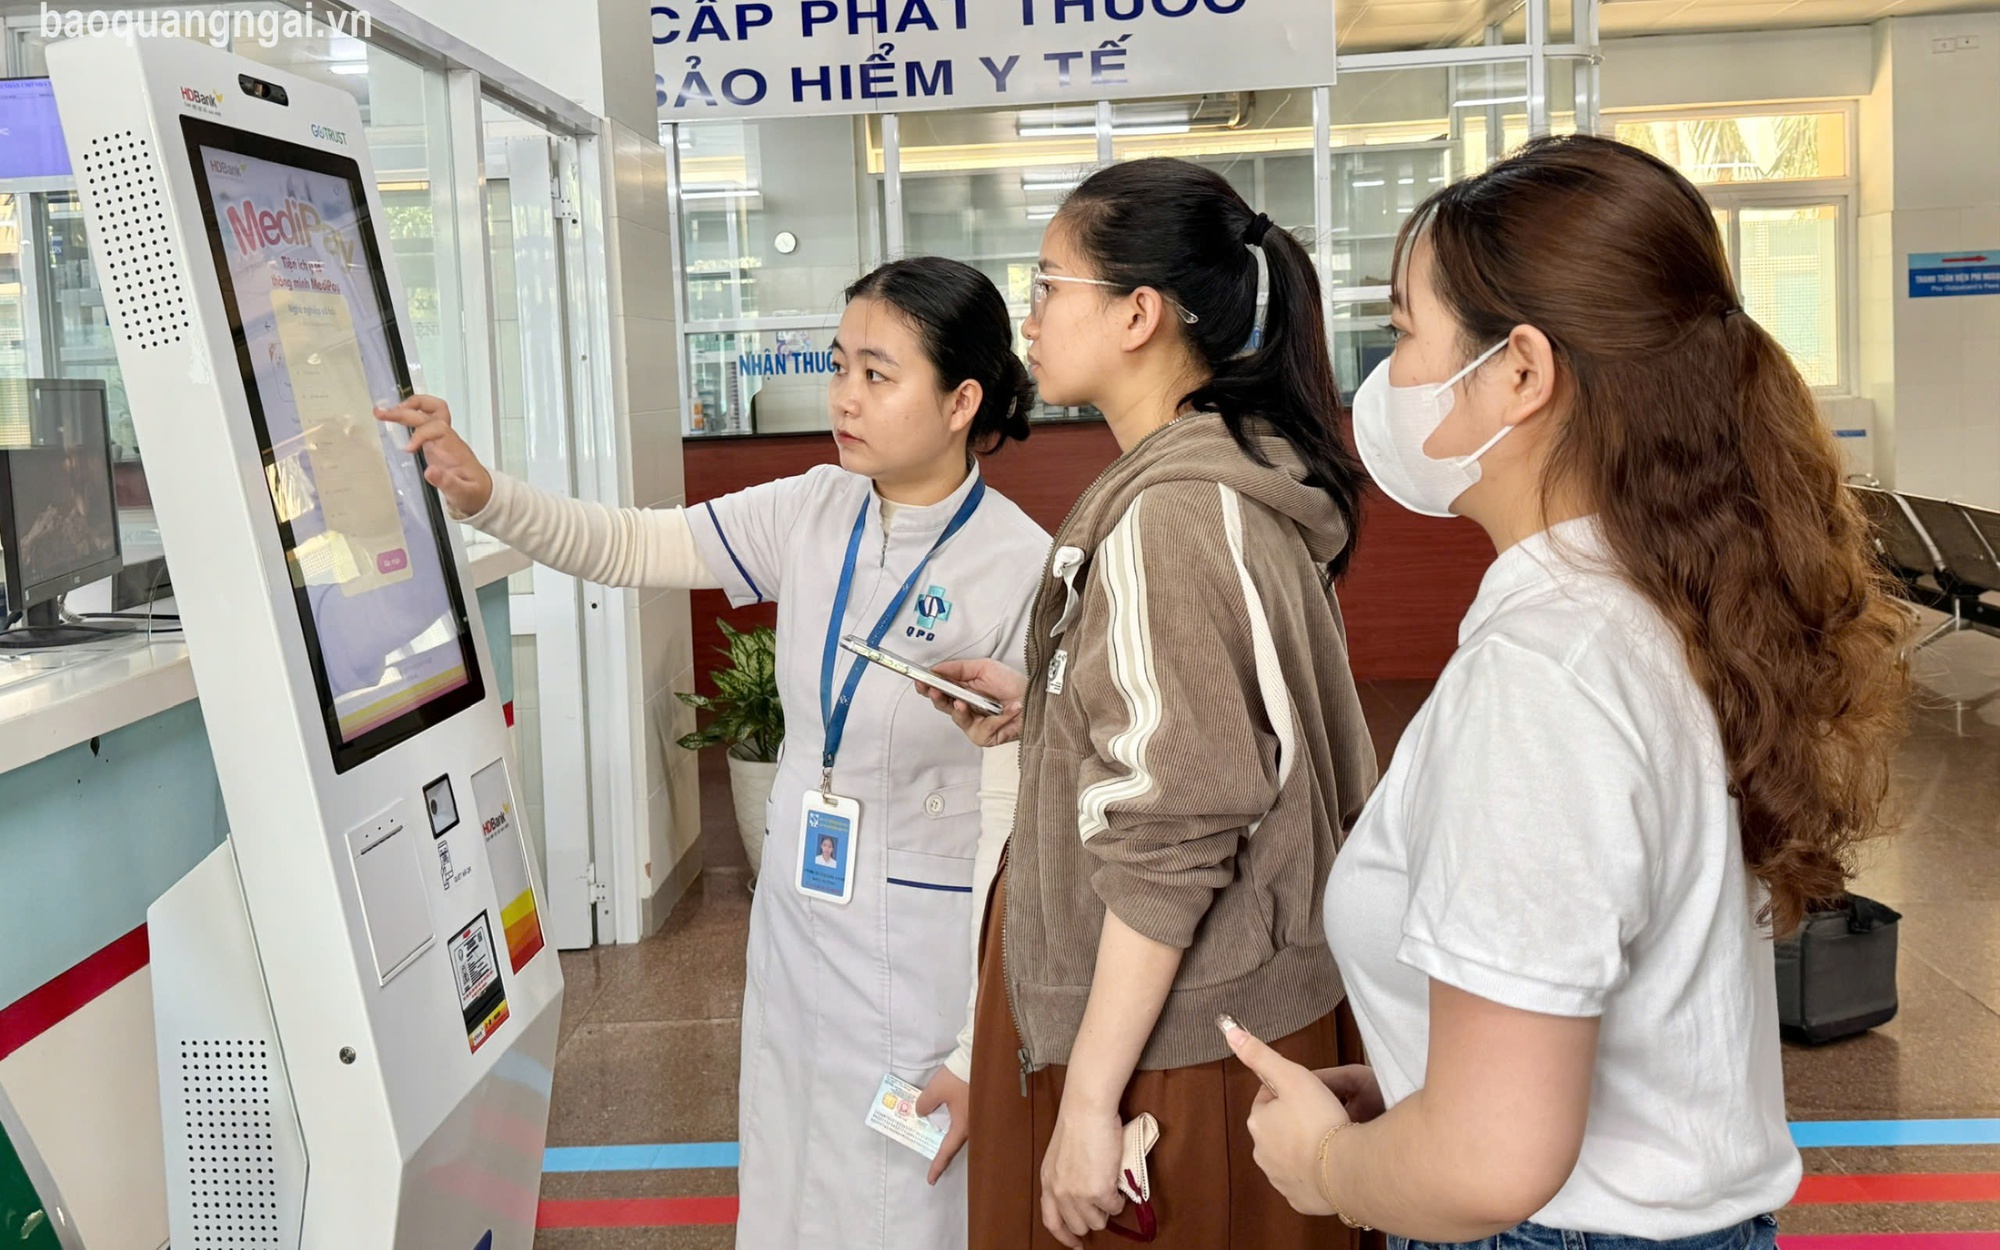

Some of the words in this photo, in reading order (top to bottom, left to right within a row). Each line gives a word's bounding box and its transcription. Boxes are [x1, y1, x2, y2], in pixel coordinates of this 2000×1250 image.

[791, 42, 954, 103] HIỂM
[979, 54, 1020, 93] Y
[1044, 33, 1134, 88] TẾ
[180, 86, 218, 108] HDBank
[226, 198, 355, 274] MediPay
[739, 348, 787, 380] NHẬN
[482, 812, 506, 836] HDBank
